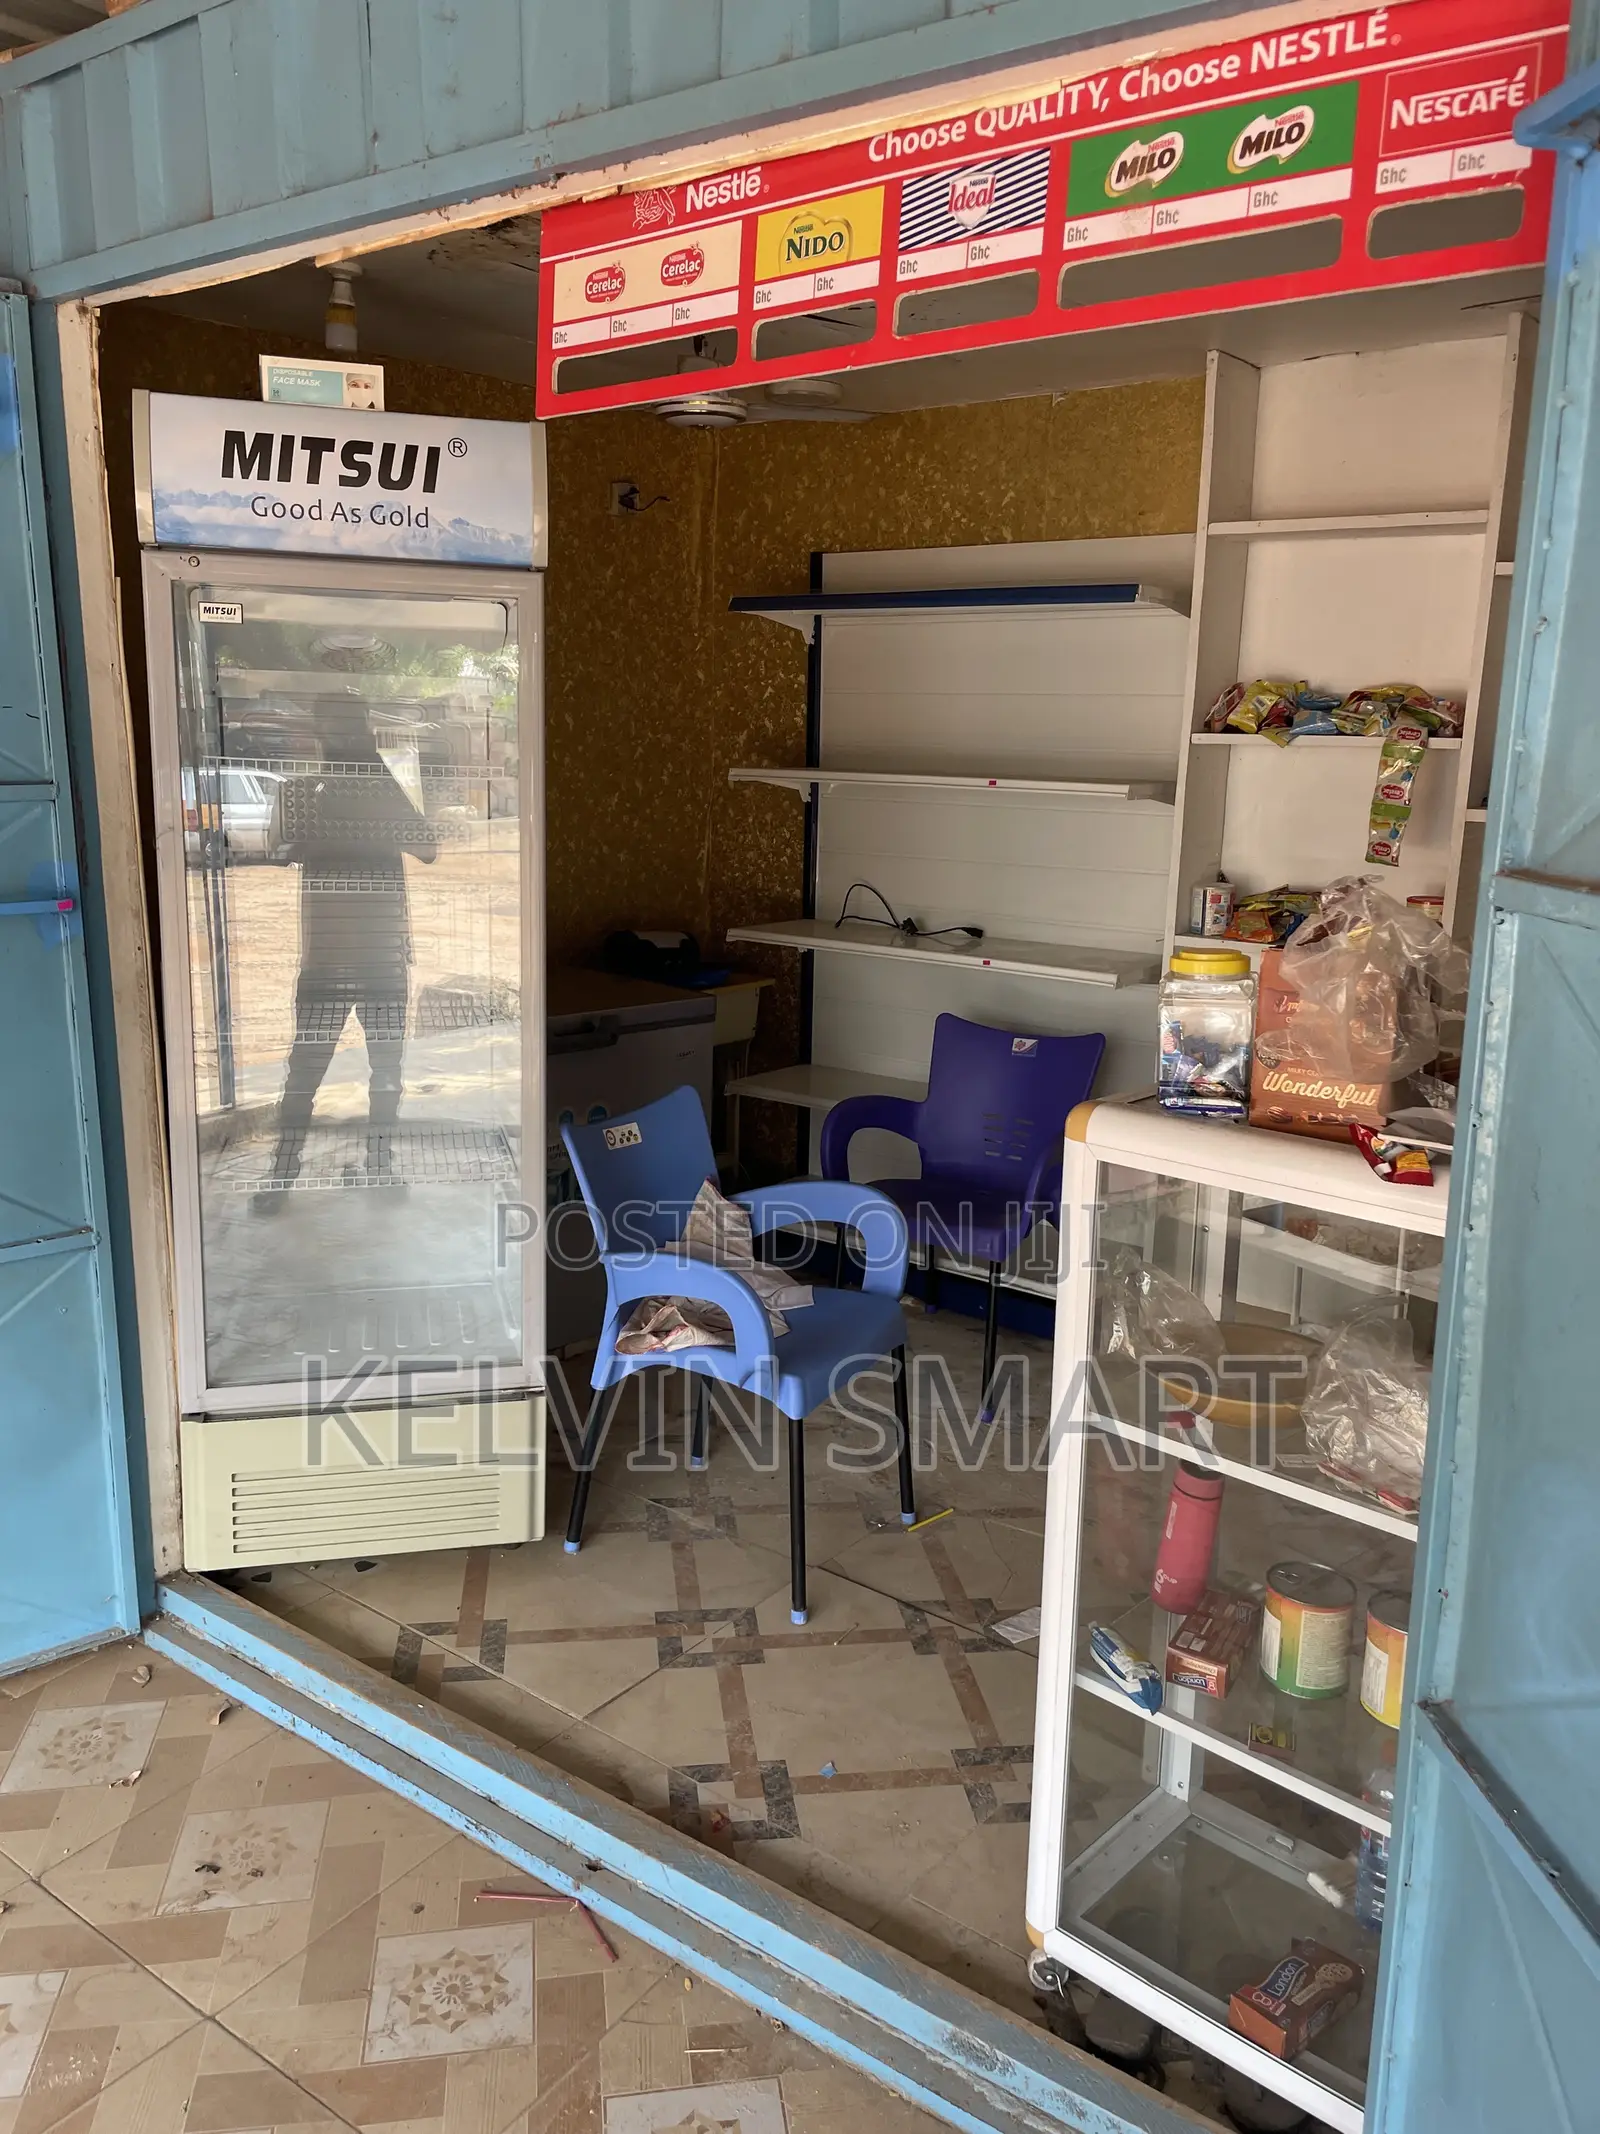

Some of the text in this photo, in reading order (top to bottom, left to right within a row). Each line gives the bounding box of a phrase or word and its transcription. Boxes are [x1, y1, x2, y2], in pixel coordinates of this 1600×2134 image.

[868, 118, 966, 162] Choose
[1119, 54, 1241, 101] Choose
[1390, 65, 1528, 130] NESCAFÉ
[1239, 122, 1305, 160] MILO
[1115, 147, 1176, 184] MILO
[686, 166, 762, 213] Nestlé
[948, 176, 996, 213] Ideal
[785, 231, 845, 262] NIDO
[662, 259, 700, 278] Cerelac
[586, 277, 623, 295] Cerelac
[272, 376, 322, 387] FACE MASK
[251, 496, 429, 529] Good As Gold
[203, 606, 237, 616] MITSUI
[1263, 1071, 1377, 1109] Wonderful
[1178, 1676, 1206, 1689] London
[1267, 1962, 1298, 1996] London
